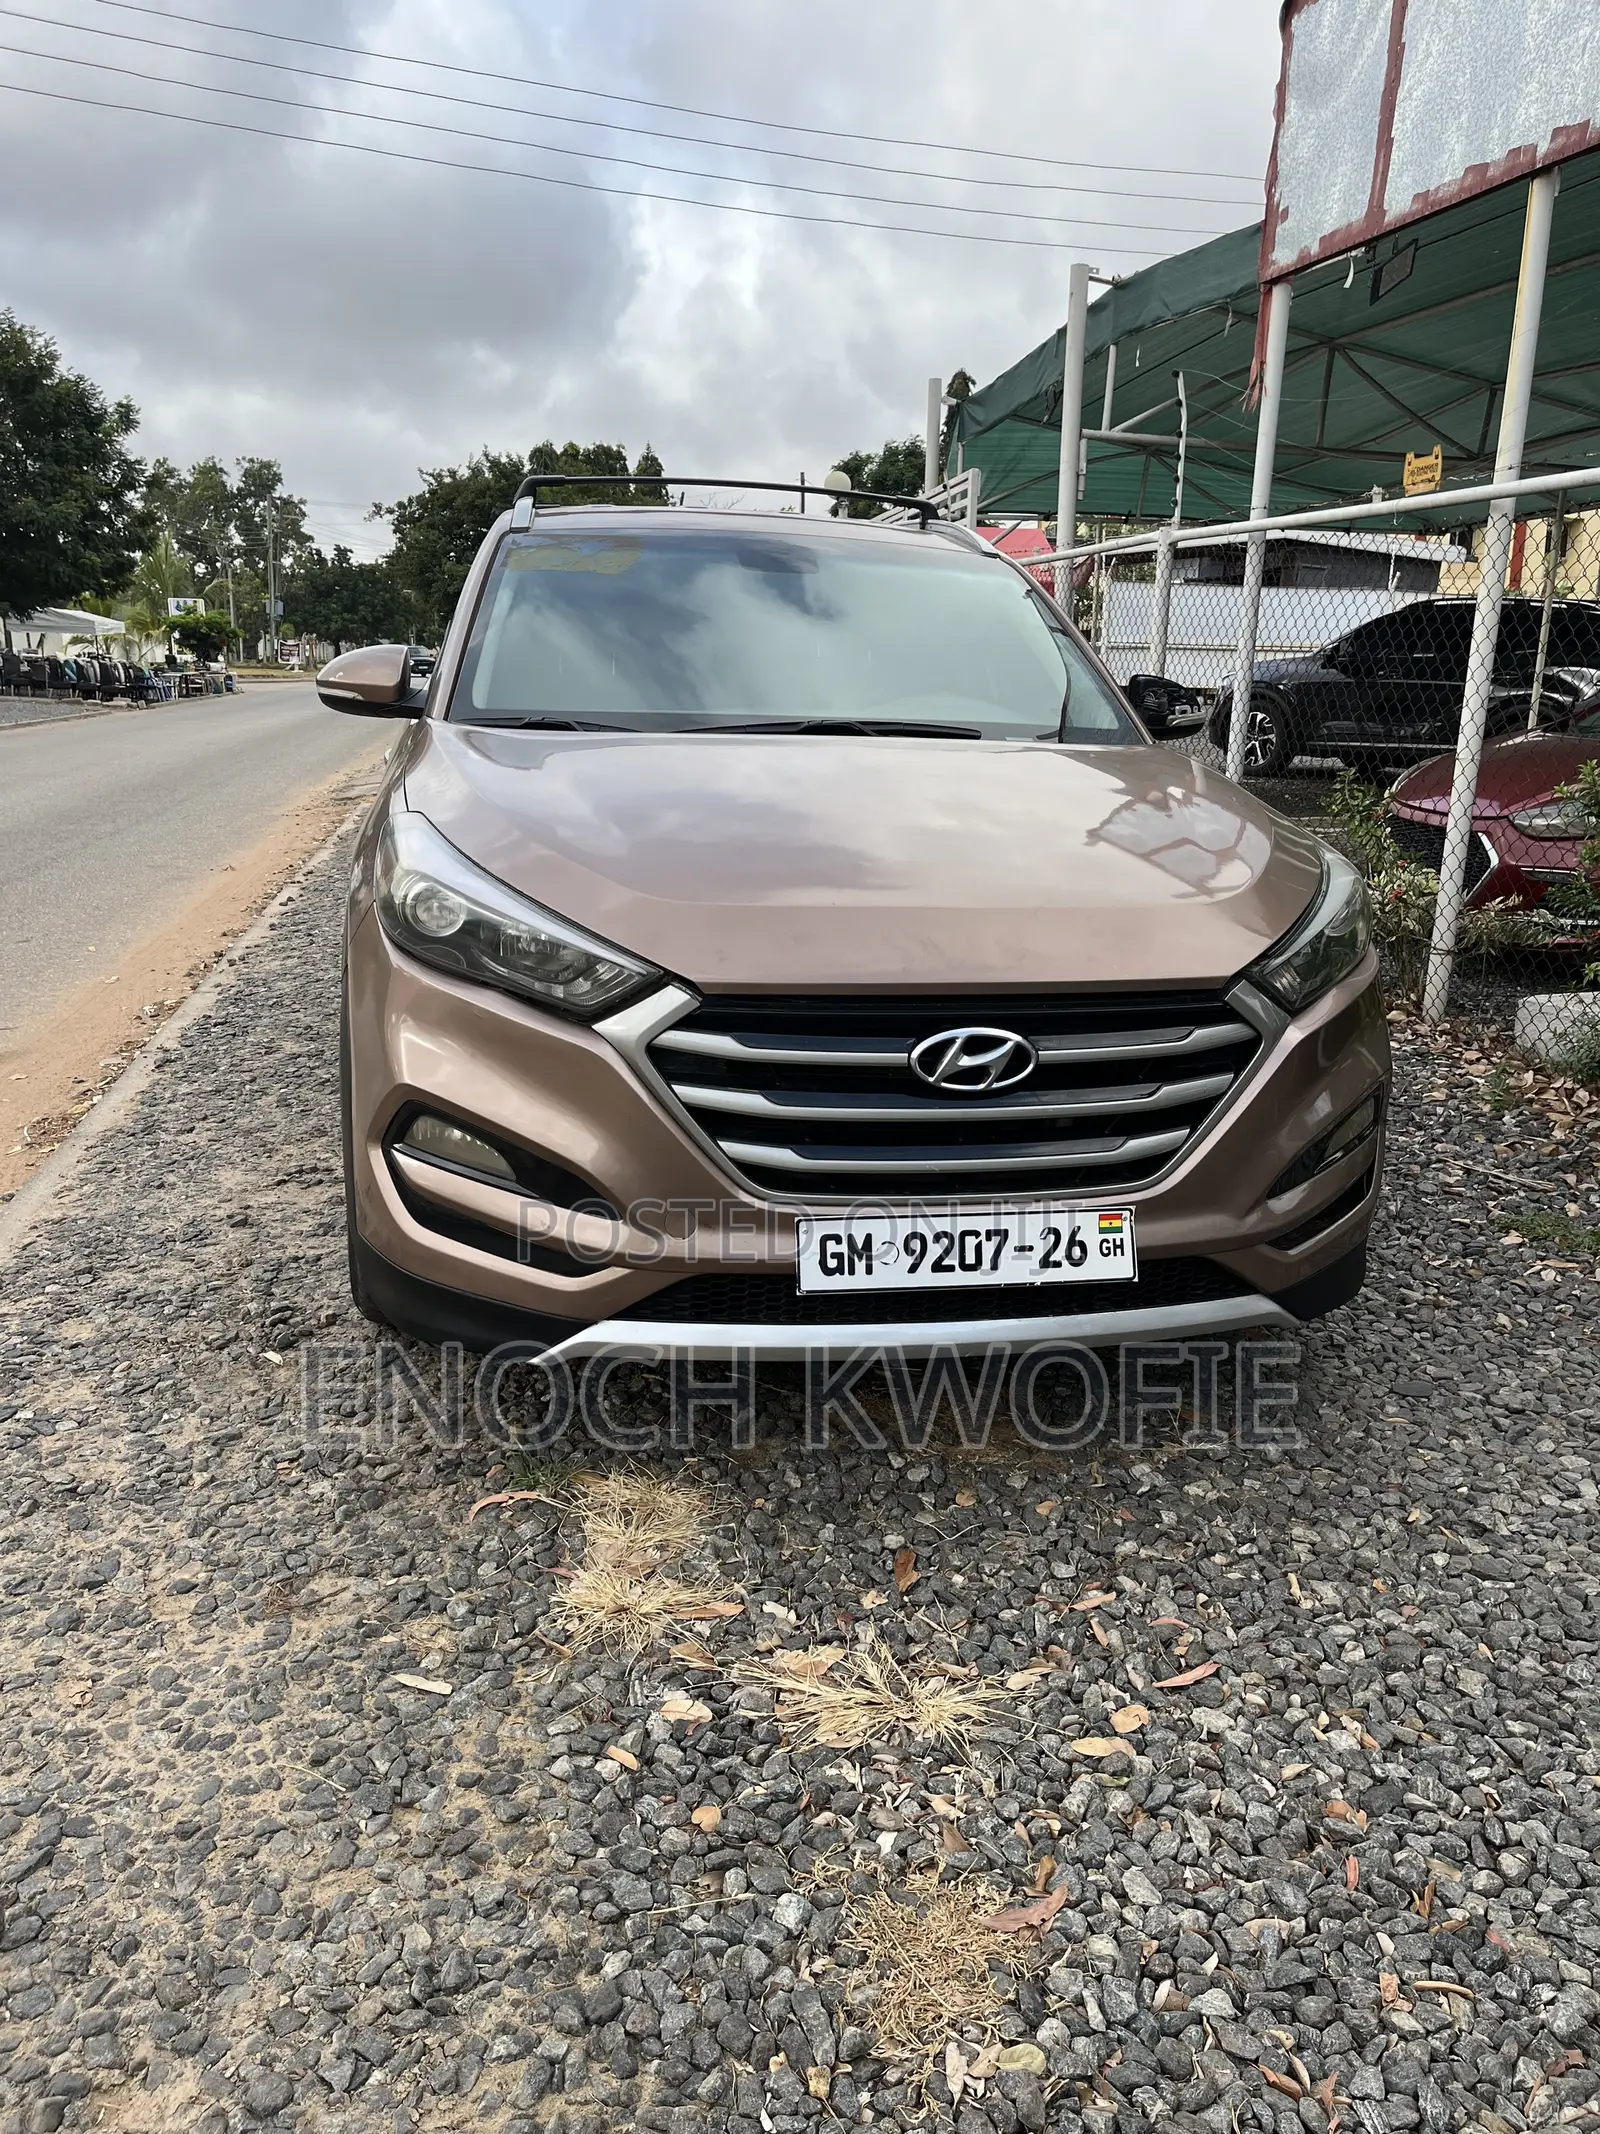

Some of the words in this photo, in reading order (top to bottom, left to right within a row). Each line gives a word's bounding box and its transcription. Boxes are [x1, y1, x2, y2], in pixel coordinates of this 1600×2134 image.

[818, 1232, 874, 1277] GM
[903, 1225, 1088, 1275] 9207-26
[1098, 1237, 1125, 1258] GH
